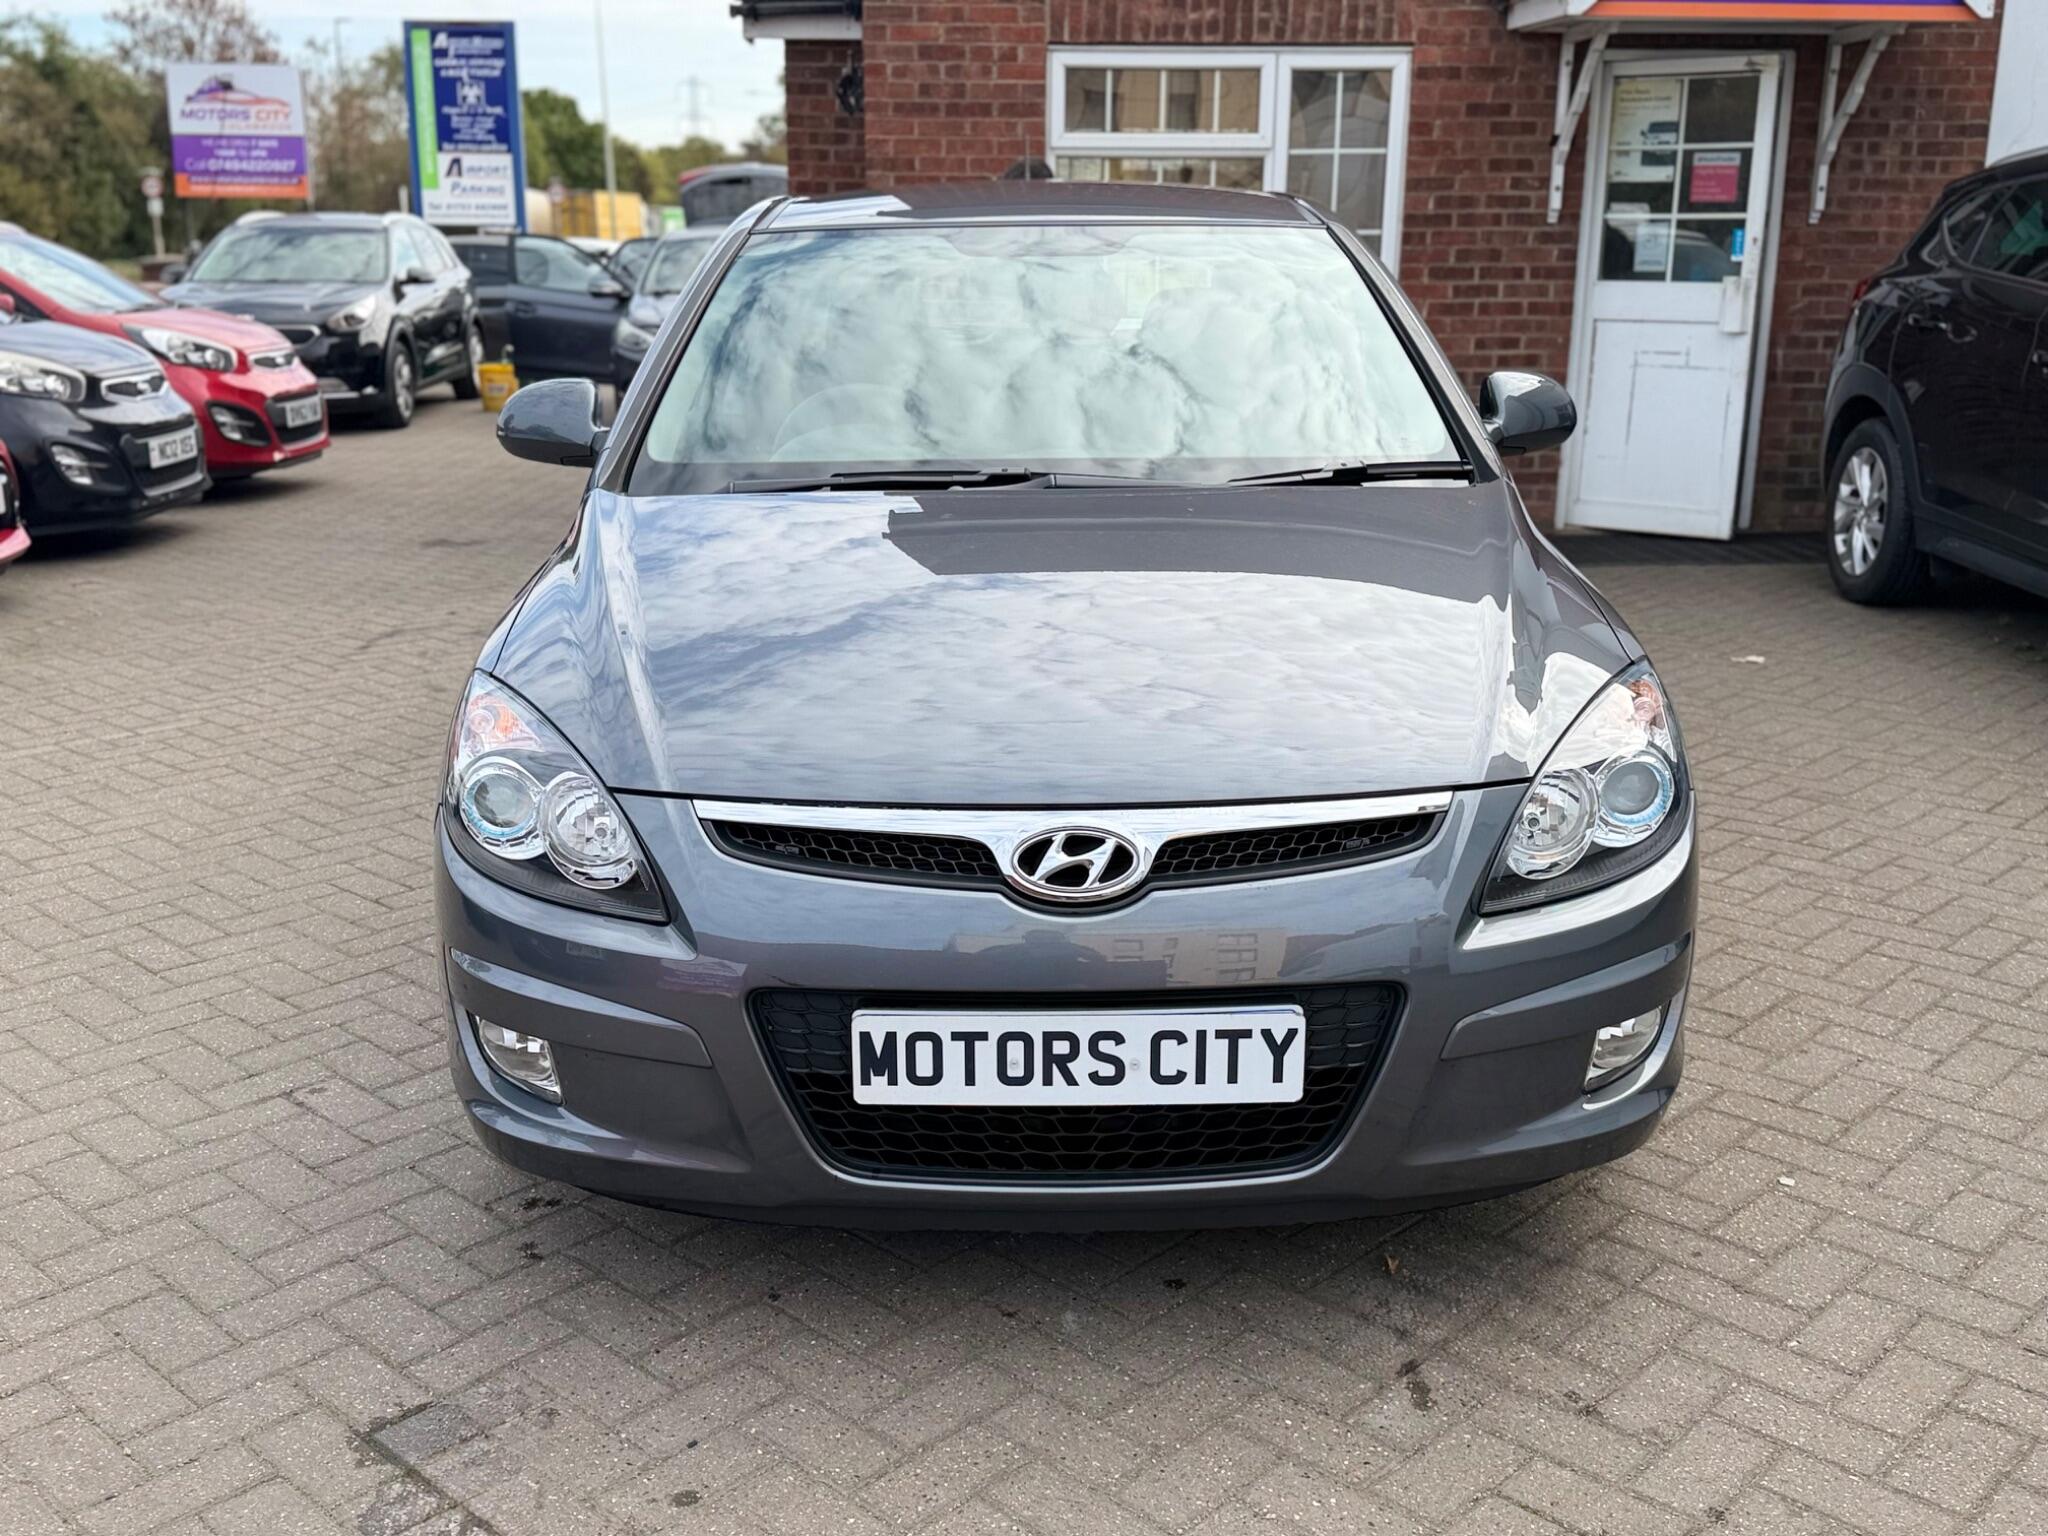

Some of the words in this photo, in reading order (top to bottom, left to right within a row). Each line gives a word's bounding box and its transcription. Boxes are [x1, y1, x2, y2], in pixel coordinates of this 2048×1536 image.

[180, 108, 250, 121] MOTORS
[255, 109, 292, 121] CITY
[859, 1030, 1126, 1087] MOTORS
[1150, 1027, 1299, 1085] CITY
